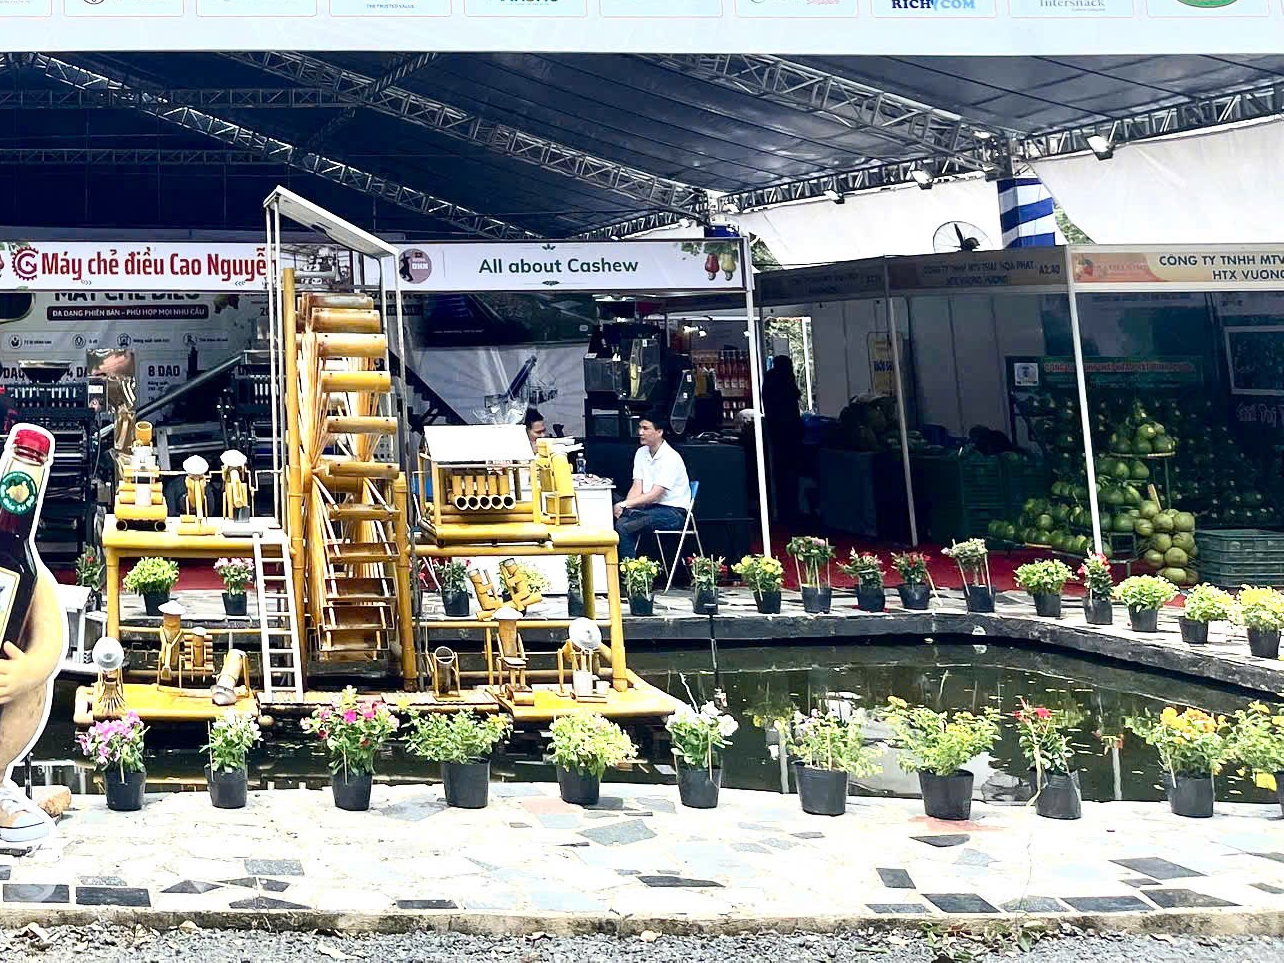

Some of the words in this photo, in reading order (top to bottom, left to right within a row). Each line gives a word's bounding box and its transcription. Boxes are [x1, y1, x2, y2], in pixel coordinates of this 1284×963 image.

[891, 0, 931, 9] RICH
[939, 0, 976, 9] COM
[42, 252, 82, 281] Máy
[88, 249, 118, 275] chẻ
[124, 247, 164, 275] điều
[170, 254, 201, 275] Cao
[1159, 254, 1197, 265] CÔNG
[1202, 255, 1215, 265] TY
[1220, 255, 1255, 265] TNHH
[1261, 255, 1284, 265] MTV
[479, 258, 503, 274] All
[509, 257, 562, 274] about
[567, 257, 638, 273] Cashew
[1213, 270, 1237, 280] HTX
[148, 365, 155, 377] 8
[158, 365, 180, 376] DAO
